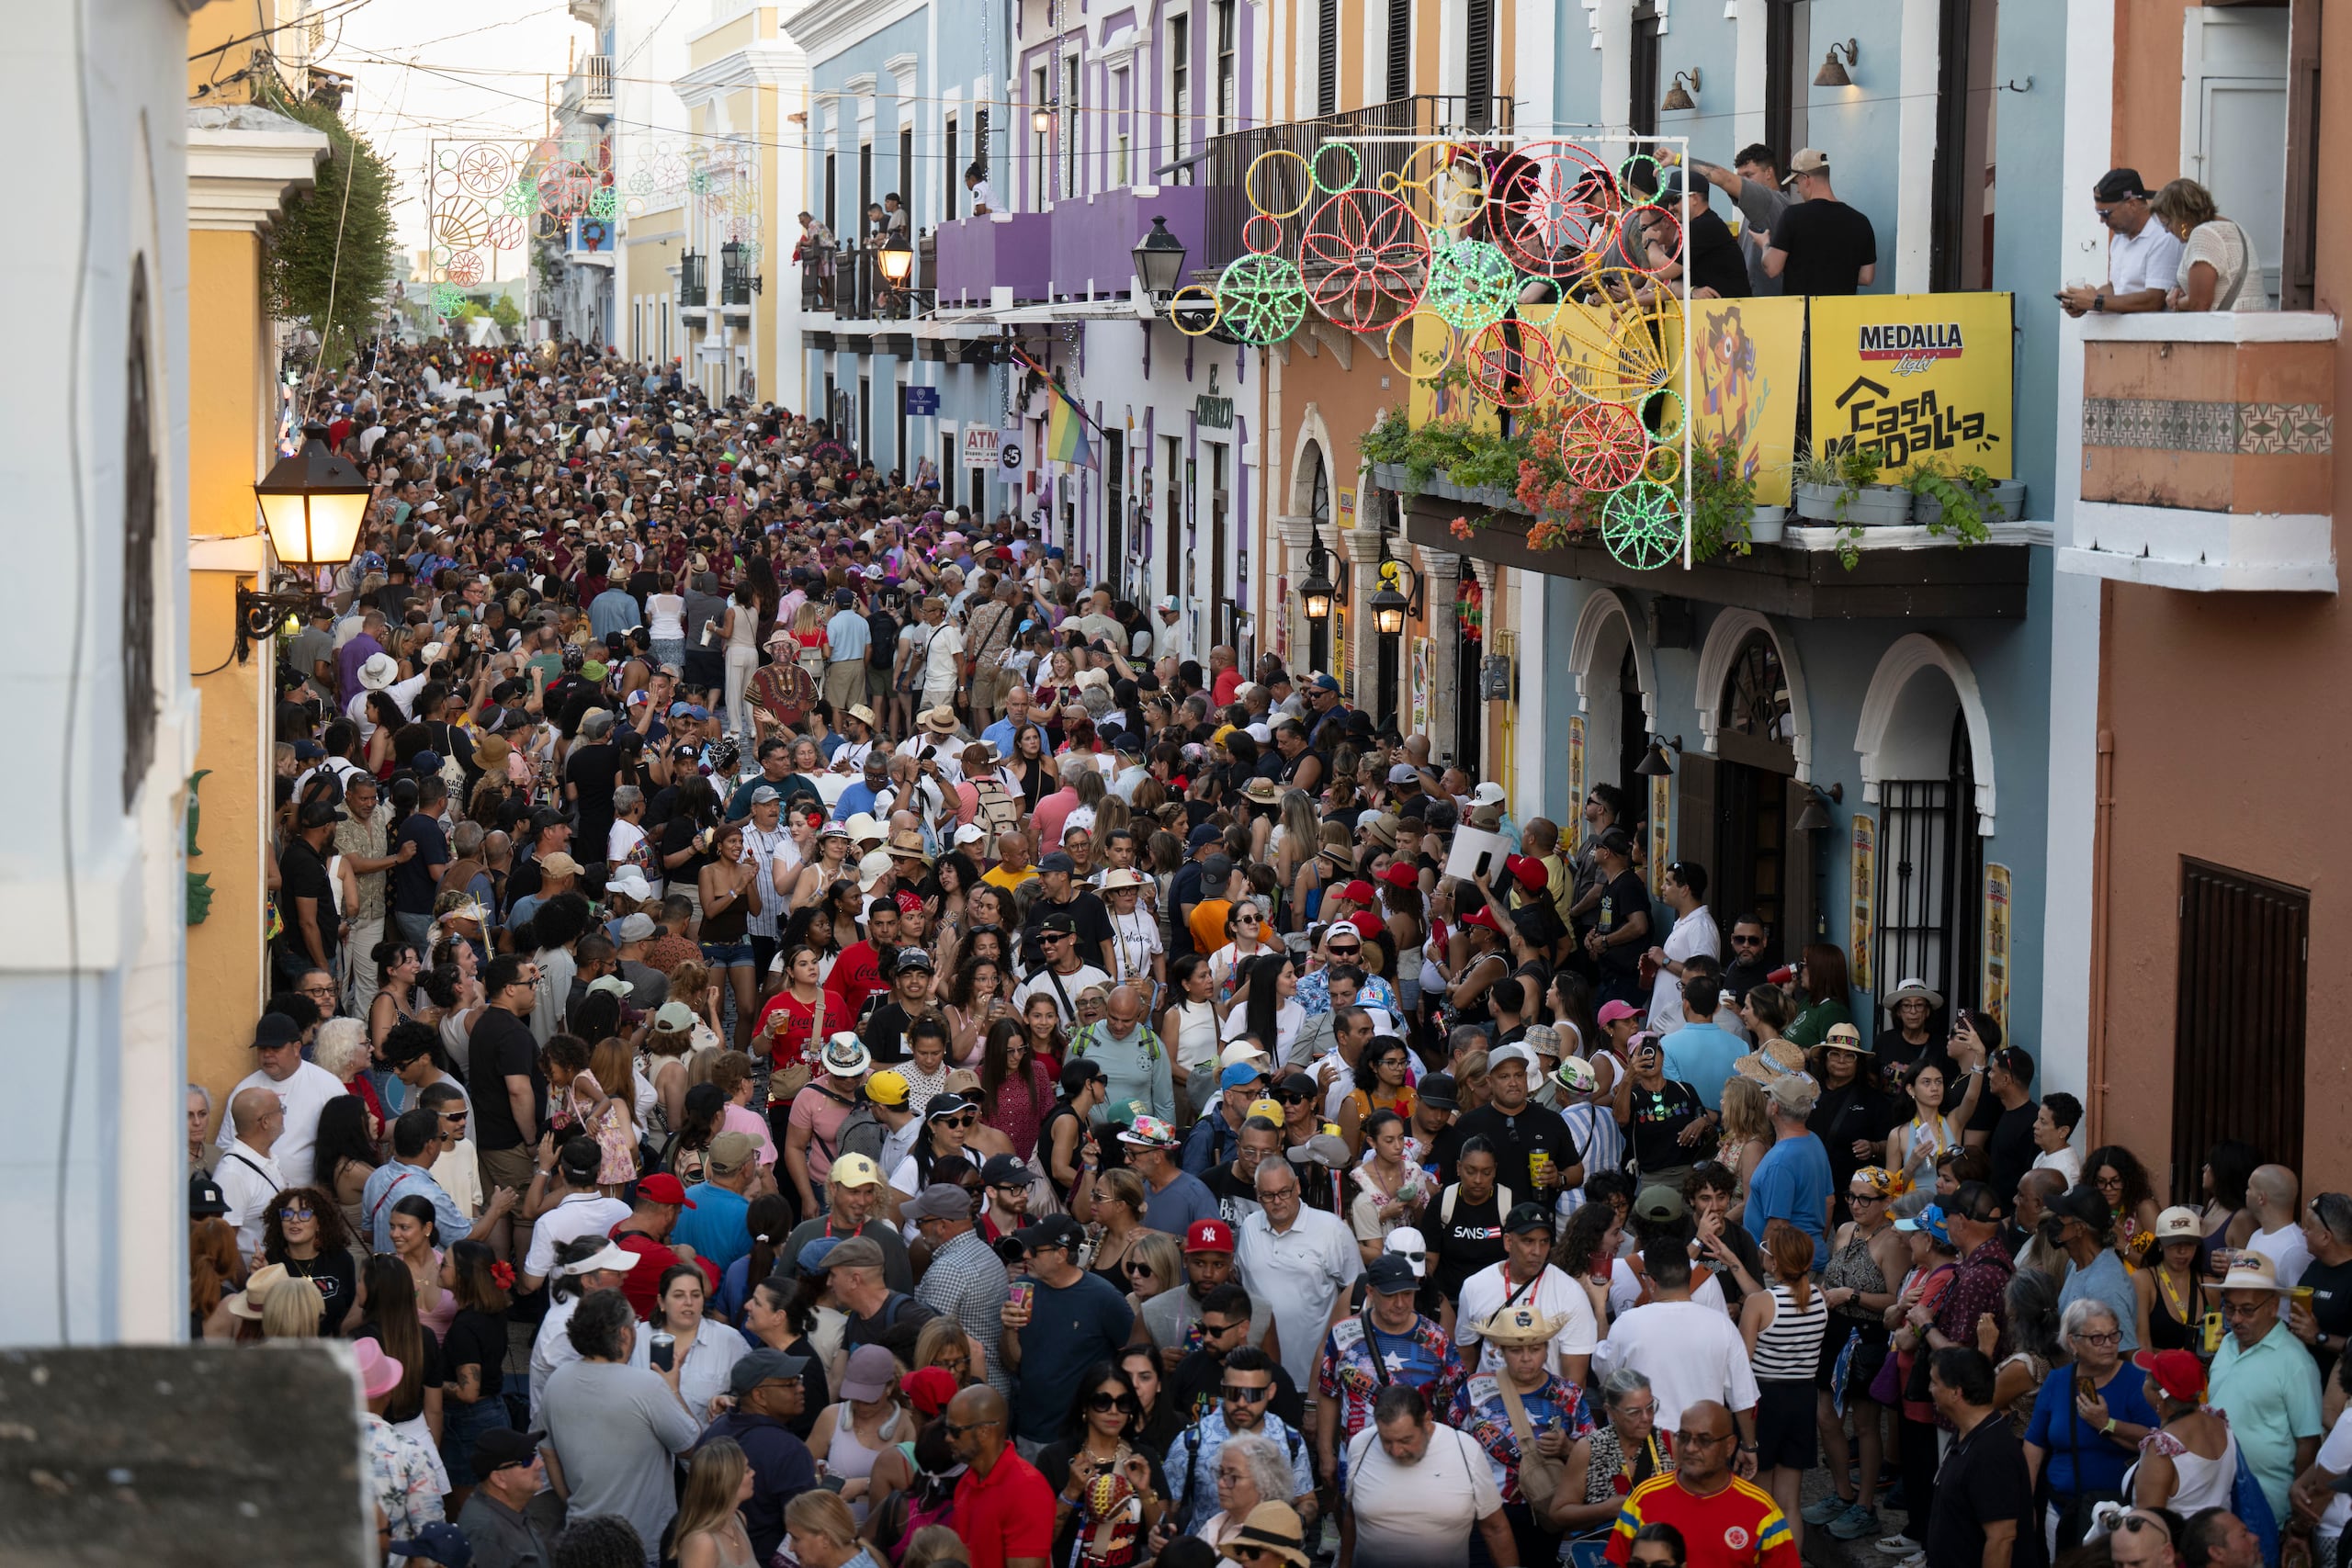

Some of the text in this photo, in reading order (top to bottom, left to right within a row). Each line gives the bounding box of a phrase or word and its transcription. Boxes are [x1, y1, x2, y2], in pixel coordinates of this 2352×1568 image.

[1860, 323, 1963, 351] MEDALLA
[1891, 353, 1938, 377] Light
[1208, 364, 1219, 395] EL
[967, 432, 999, 448] ATM
[1202, 1226, 1216, 1242] NY
[1196, 1391, 1207, 1404] LA
